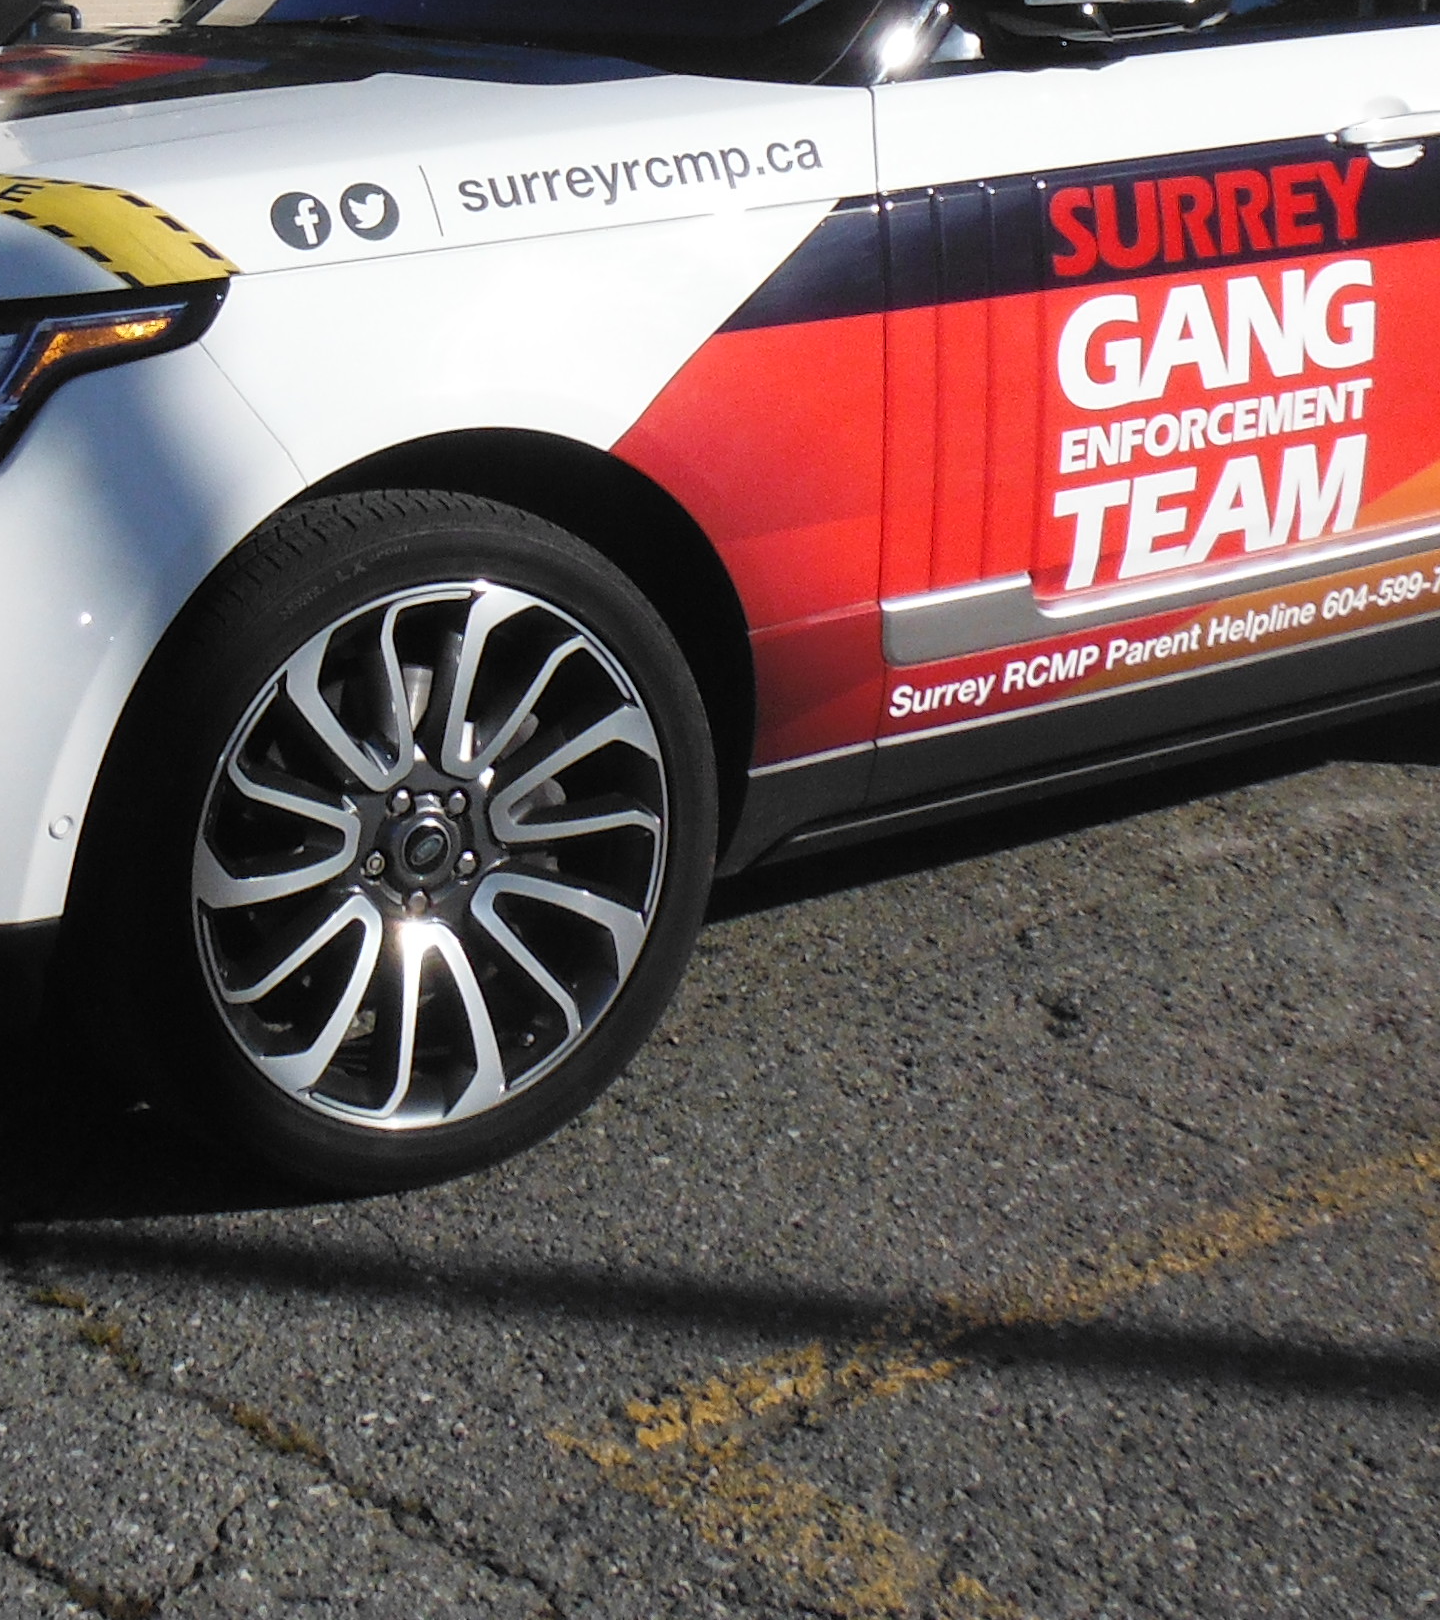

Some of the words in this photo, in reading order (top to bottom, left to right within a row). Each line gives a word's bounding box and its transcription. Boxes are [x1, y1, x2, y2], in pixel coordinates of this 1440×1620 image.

[458, 136, 823, 214] surreyrcmp.ca
[1048, 157, 1370, 277] SURREY
[1057, 260, 1376, 411] GANG
[1058, 379, 1373, 474] ENFORCEMENT
[1053, 434, 1368, 591] TEAM
[888, 676, 996, 719] Surrey
[1002, 646, 1100, 692] RCMP
[1105, 625, 1202, 671] Parent
[1207, 602, 1317, 649] Helpline
